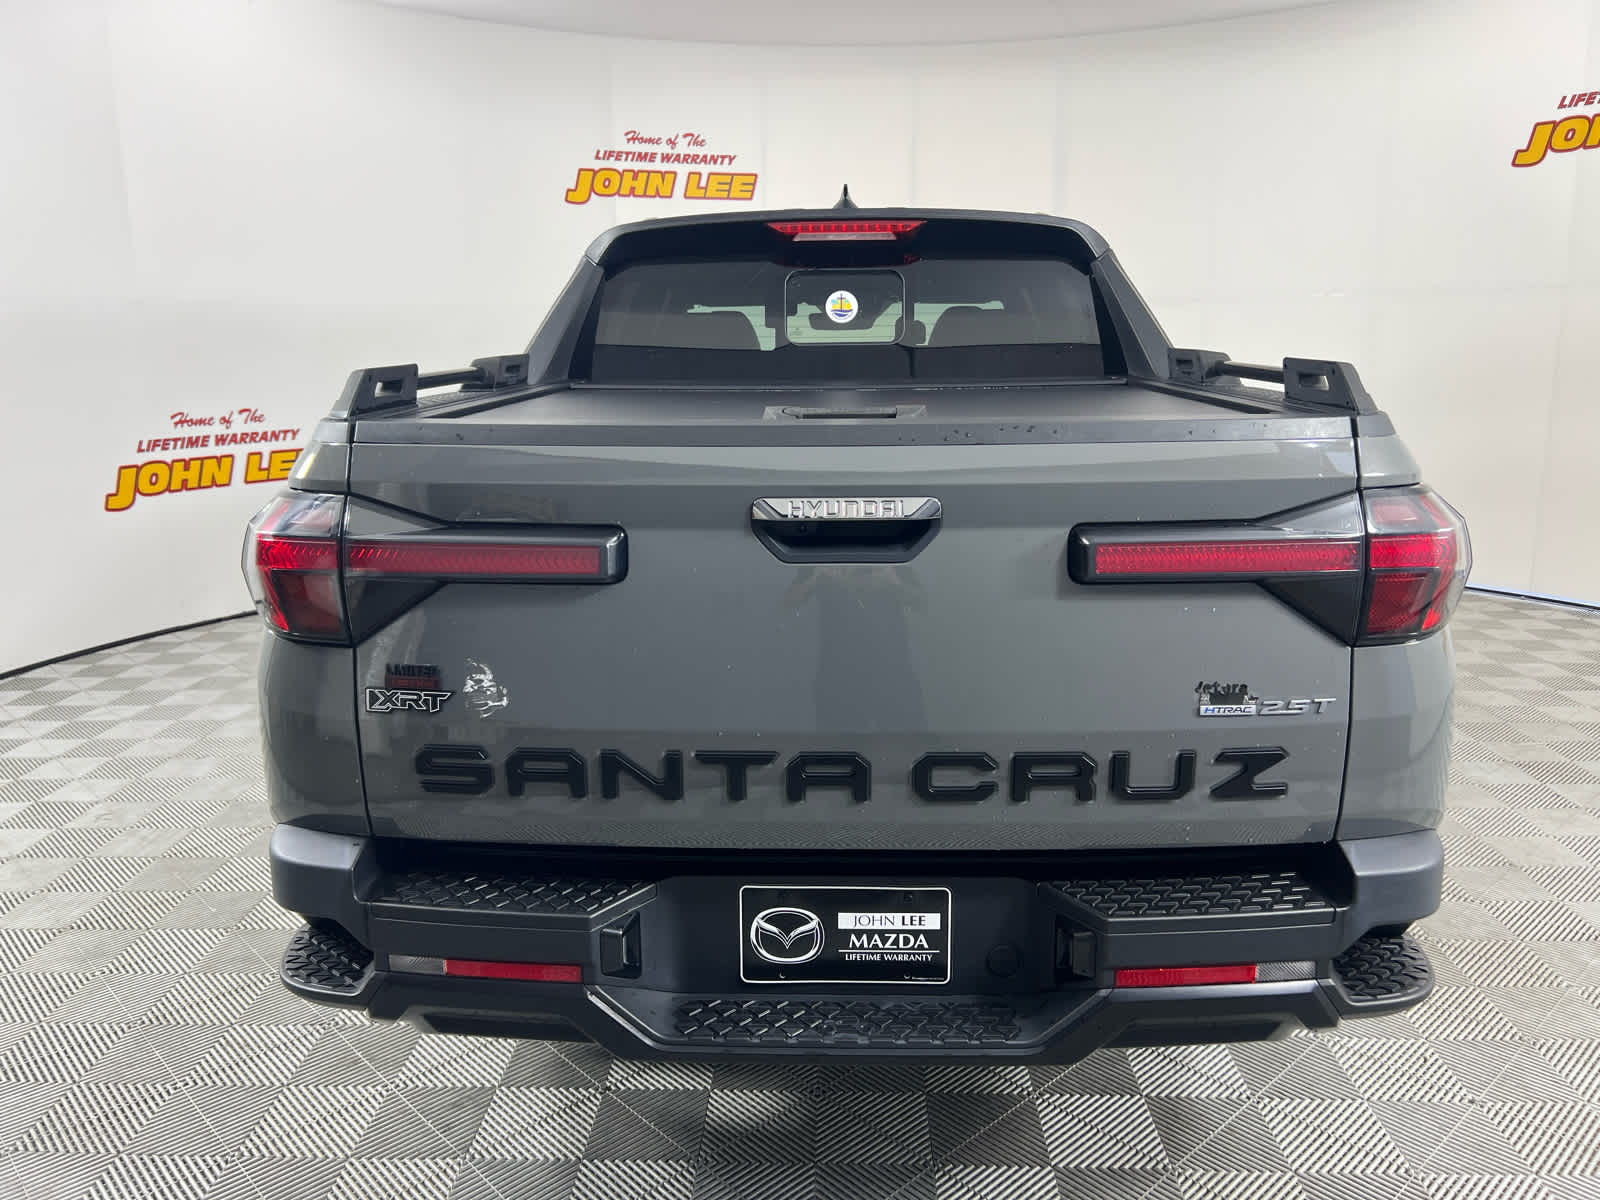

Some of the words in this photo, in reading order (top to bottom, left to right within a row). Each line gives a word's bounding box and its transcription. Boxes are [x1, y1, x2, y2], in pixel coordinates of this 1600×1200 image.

[1557, 91, 1600, 109] LIFE
[624, 130, 662, 146] Home
[665, 134, 680, 149] of
[682, 132, 706, 147] The
[594, 149, 657, 163] LIFETIME
[660, 152, 736, 165] WARRANTY
[565, 168, 677, 205] JOHN
[684, 171, 758, 200] LEE
[170, 411, 214, 428] Home
[219, 410, 233, 429] of
[238, 408, 265, 424] The
[136, 435, 210, 453] LIFETIME
[214, 428, 301, 450] WARRANTY
[104, 454, 235, 512] JOHN
[244, 448, 304, 484] LE
[788, 499, 905, 518] HYUNDAI
[366, 688, 453, 712] XRT
[1203, 706, 1254, 714] HTRAC
[415, 744, 872, 802] SANTA
[911, 746, 1289, 802] CRUZ
[854, 915, 895, 928] JOHN
[901, 915, 926, 926] LEE
[849, 933, 929, 949] MAZDA
[845, 953, 881, 961] LIFETIME
[884, 953, 933, 962] WARRANTY
